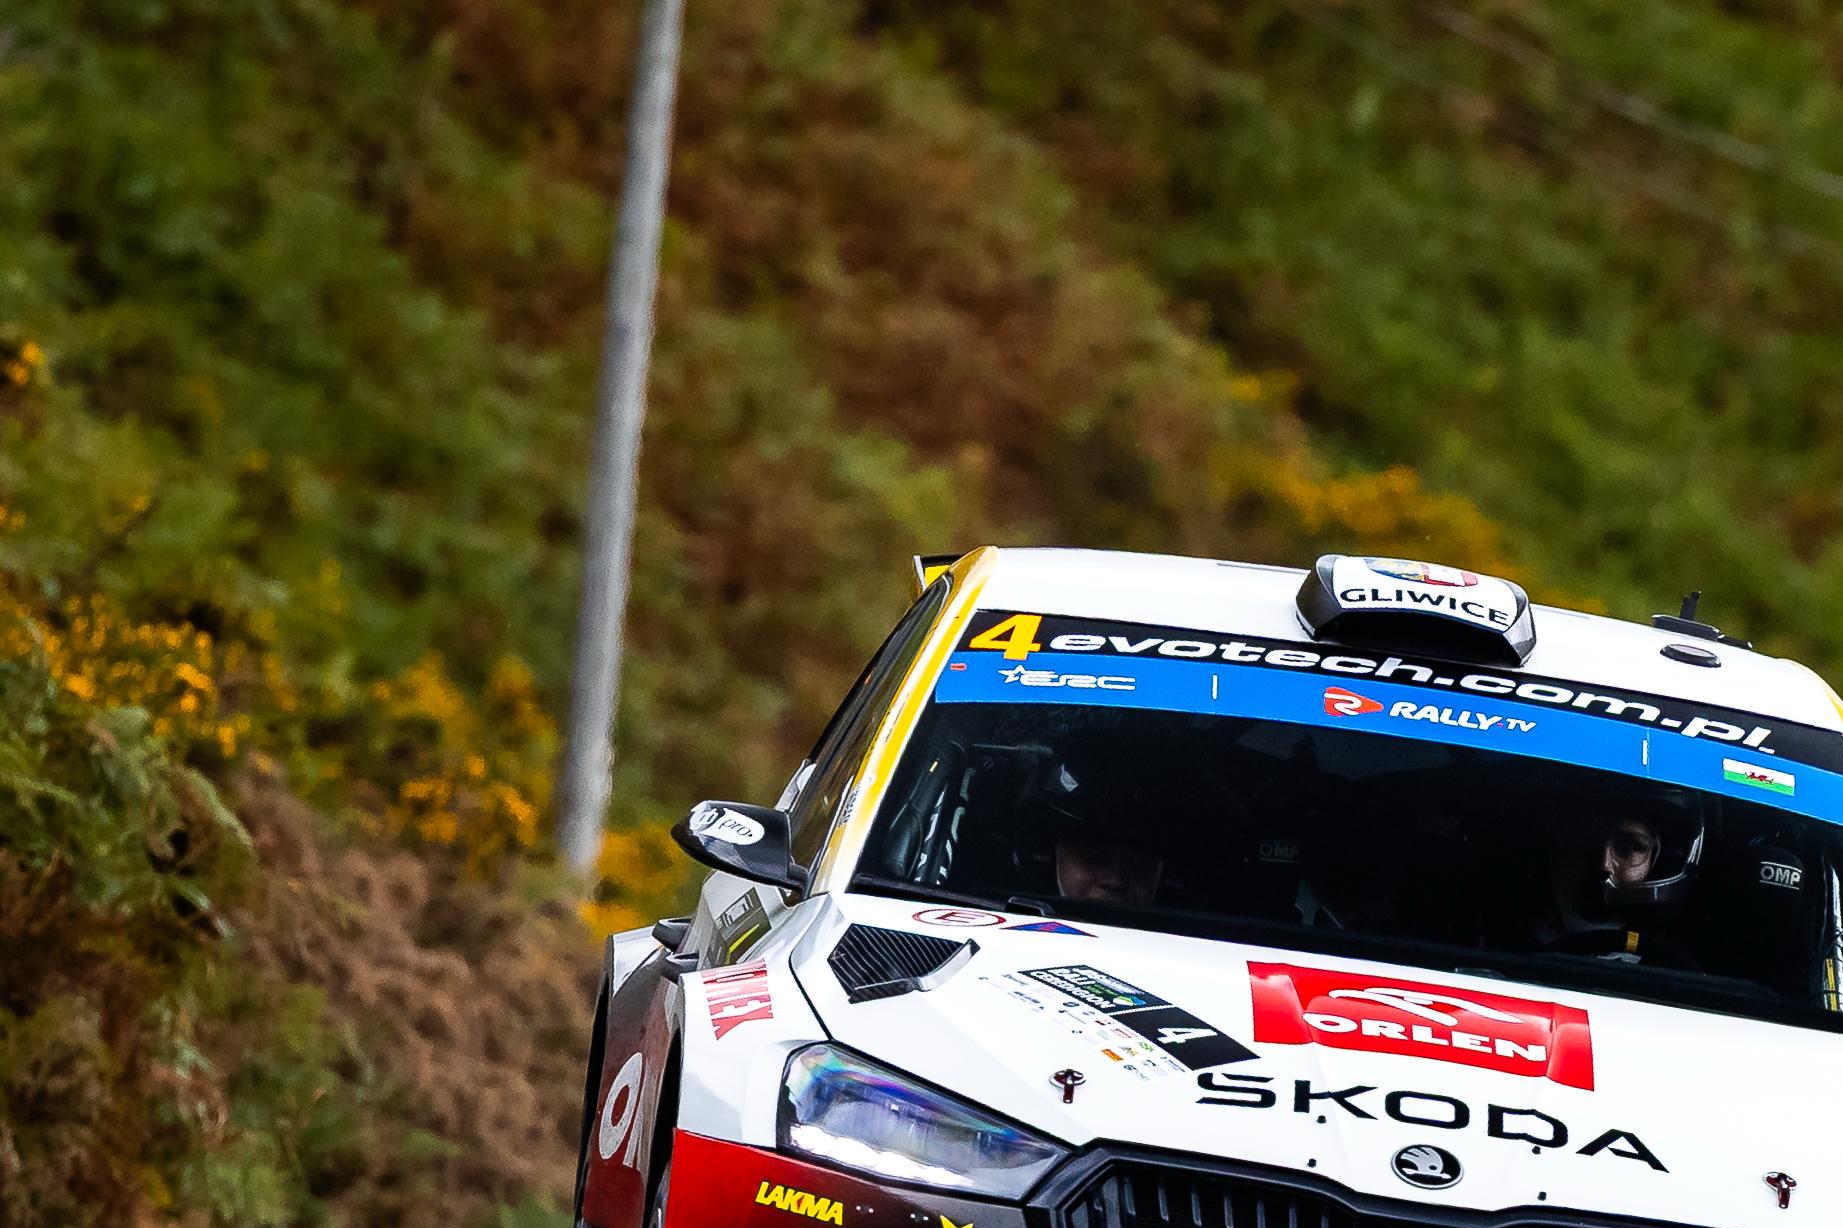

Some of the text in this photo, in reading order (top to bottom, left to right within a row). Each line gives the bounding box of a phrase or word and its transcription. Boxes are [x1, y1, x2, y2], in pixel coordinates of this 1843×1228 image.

[1339, 587, 1511, 626] GLIWICE
[969, 614, 1043, 661] 4
[1760, 864, 1802, 887] OMP
[1303, 1012, 1547, 1063] ORLEN
[755, 1181, 845, 1227] LAKMA
